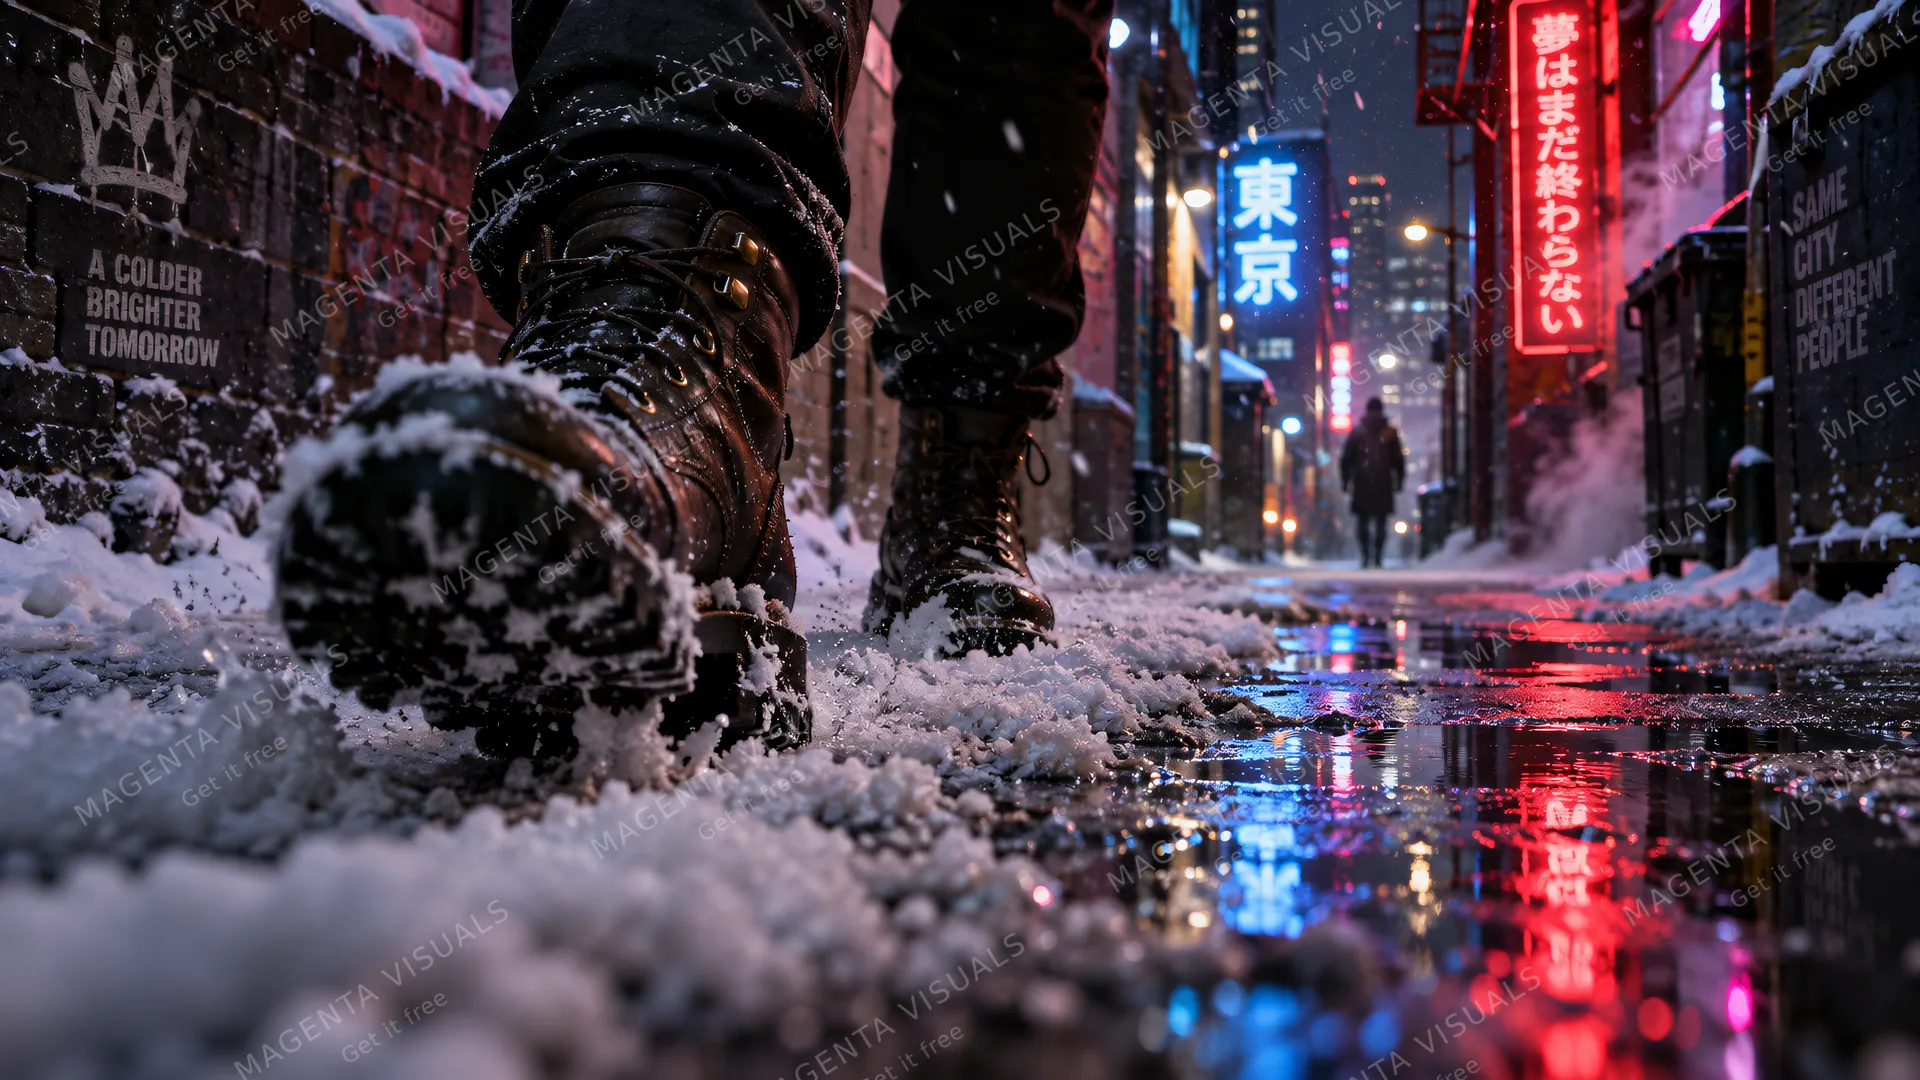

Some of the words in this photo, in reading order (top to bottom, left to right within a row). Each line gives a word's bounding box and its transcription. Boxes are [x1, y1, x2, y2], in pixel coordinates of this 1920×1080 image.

[1531, 13, 1583, 334] 夢はまだ終わらない
[1793, 165, 1848, 233] SAME
[1233, 157, 1298, 305] 東京
[1794, 220, 1838, 280] CITY
[88, 248, 105, 281] A
[114, 254, 202, 296] COLDER
[1796, 249, 1897, 327] DIFFERENT
[87, 287, 201, 331] BRIGHTER
[85, 324, 220, 367] TOMORROW
[1797, 312, 1869, 374] PEOPLE
